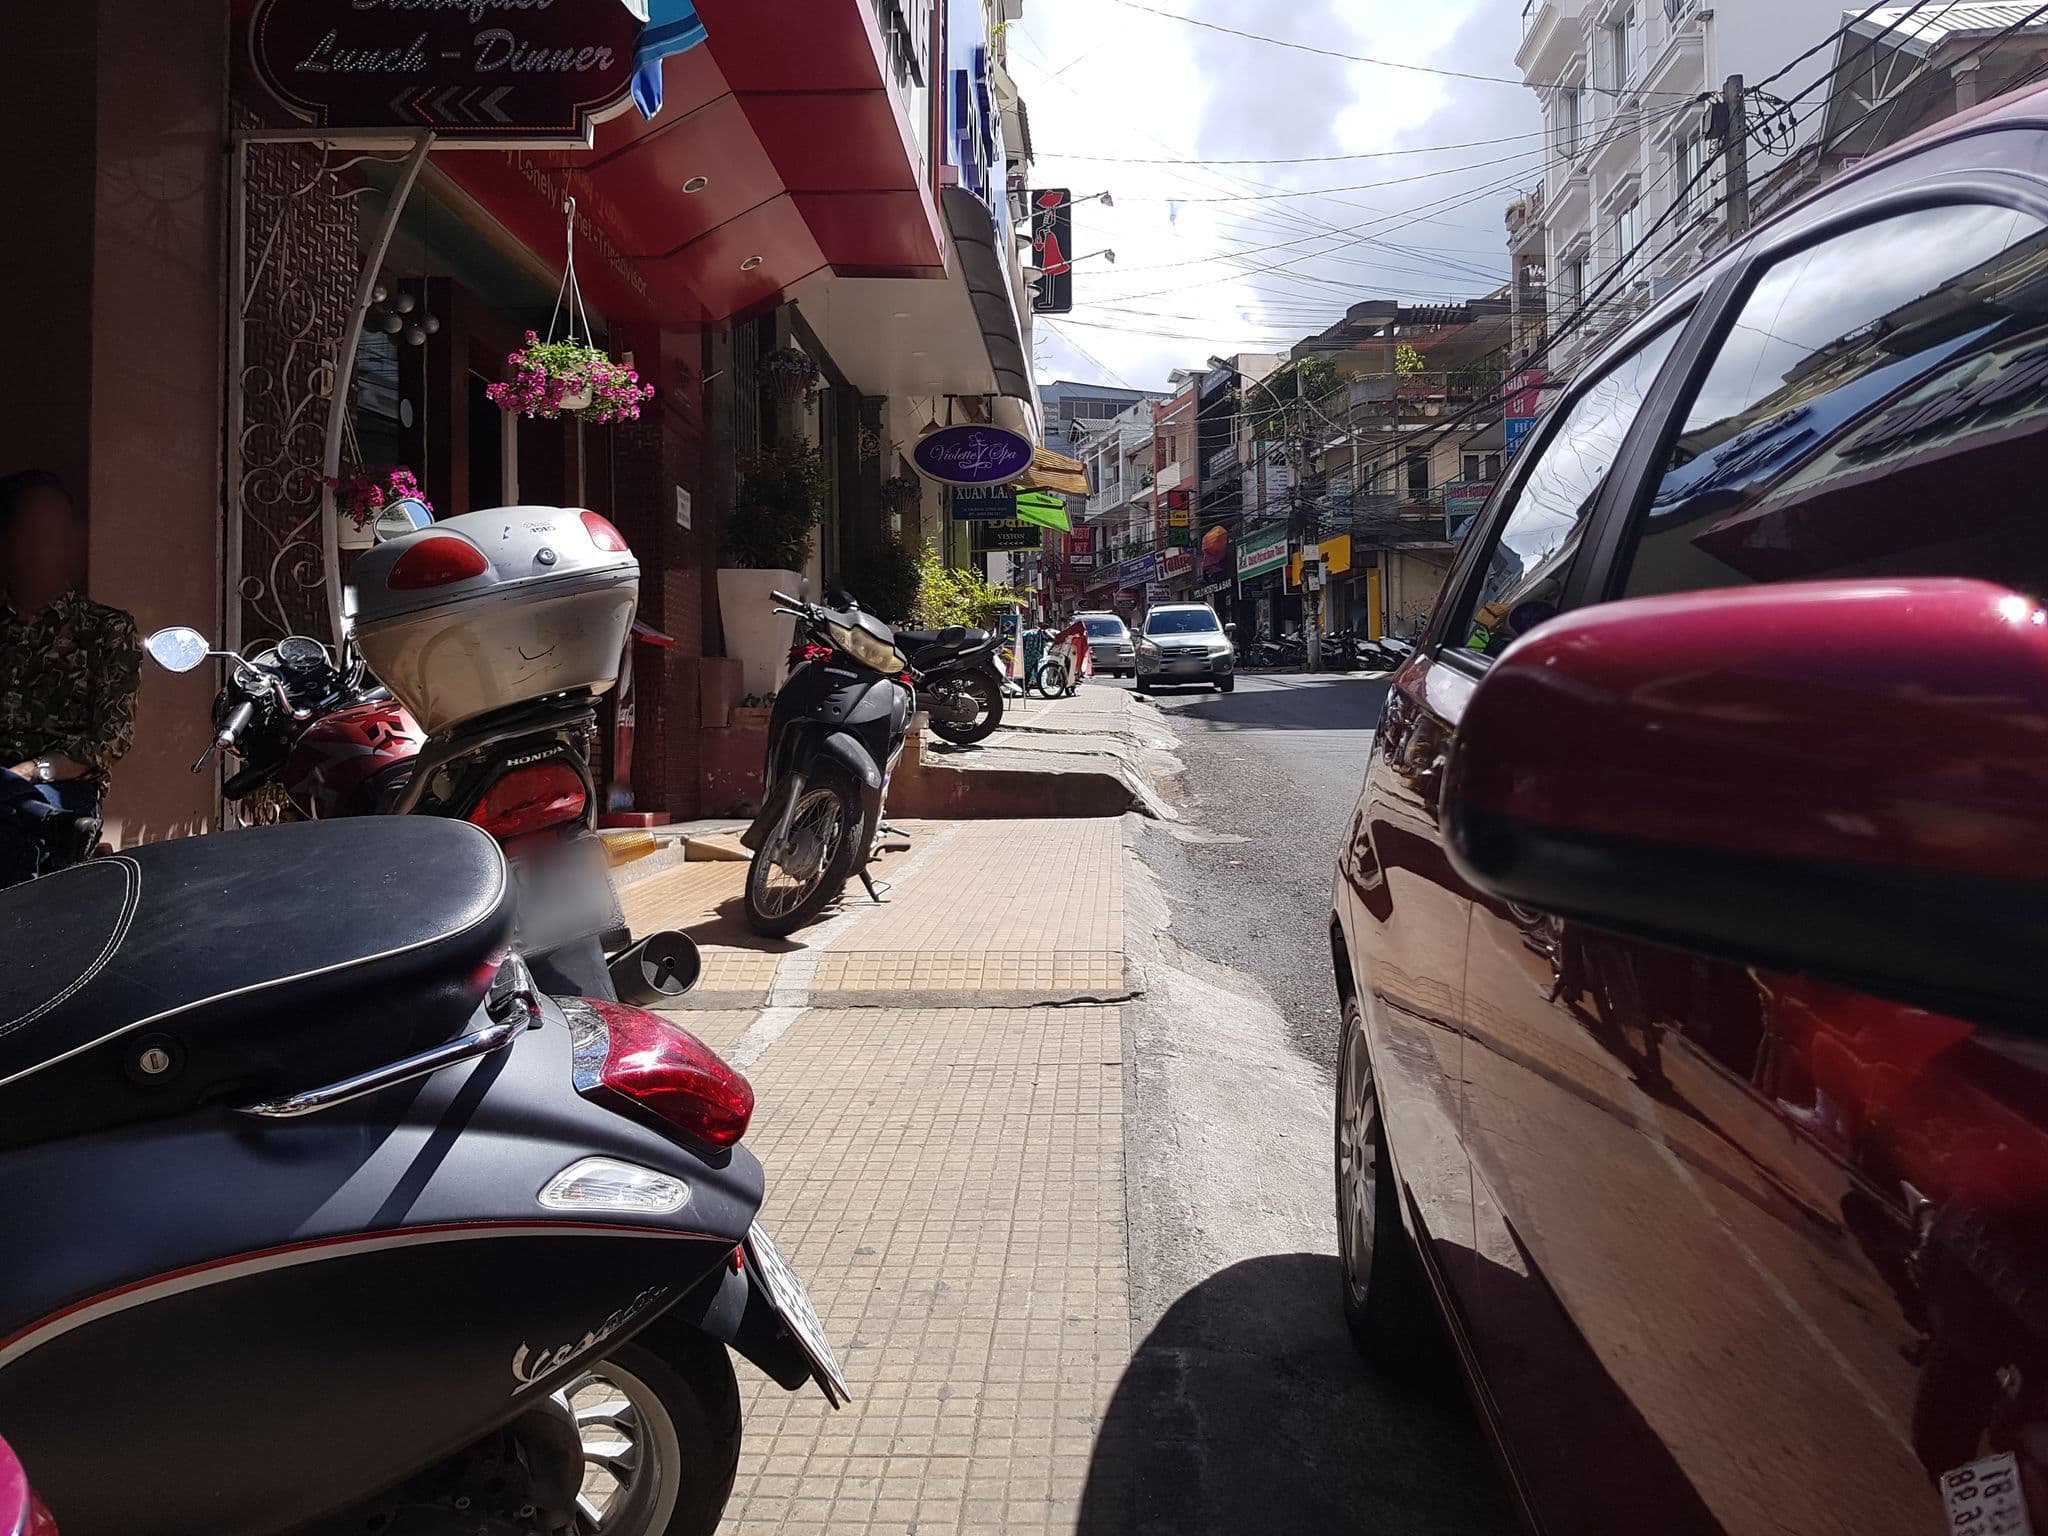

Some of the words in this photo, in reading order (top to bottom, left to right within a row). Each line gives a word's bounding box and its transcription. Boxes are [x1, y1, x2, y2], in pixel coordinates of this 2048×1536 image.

[293, 27, 429, 74] Lunch
[472, 27, 616, 74] Dinner
[929, 443, 976, 465] Violette
[988, 446, 1017, 466] Spa
[506, 745, 565, 767] HONDA
